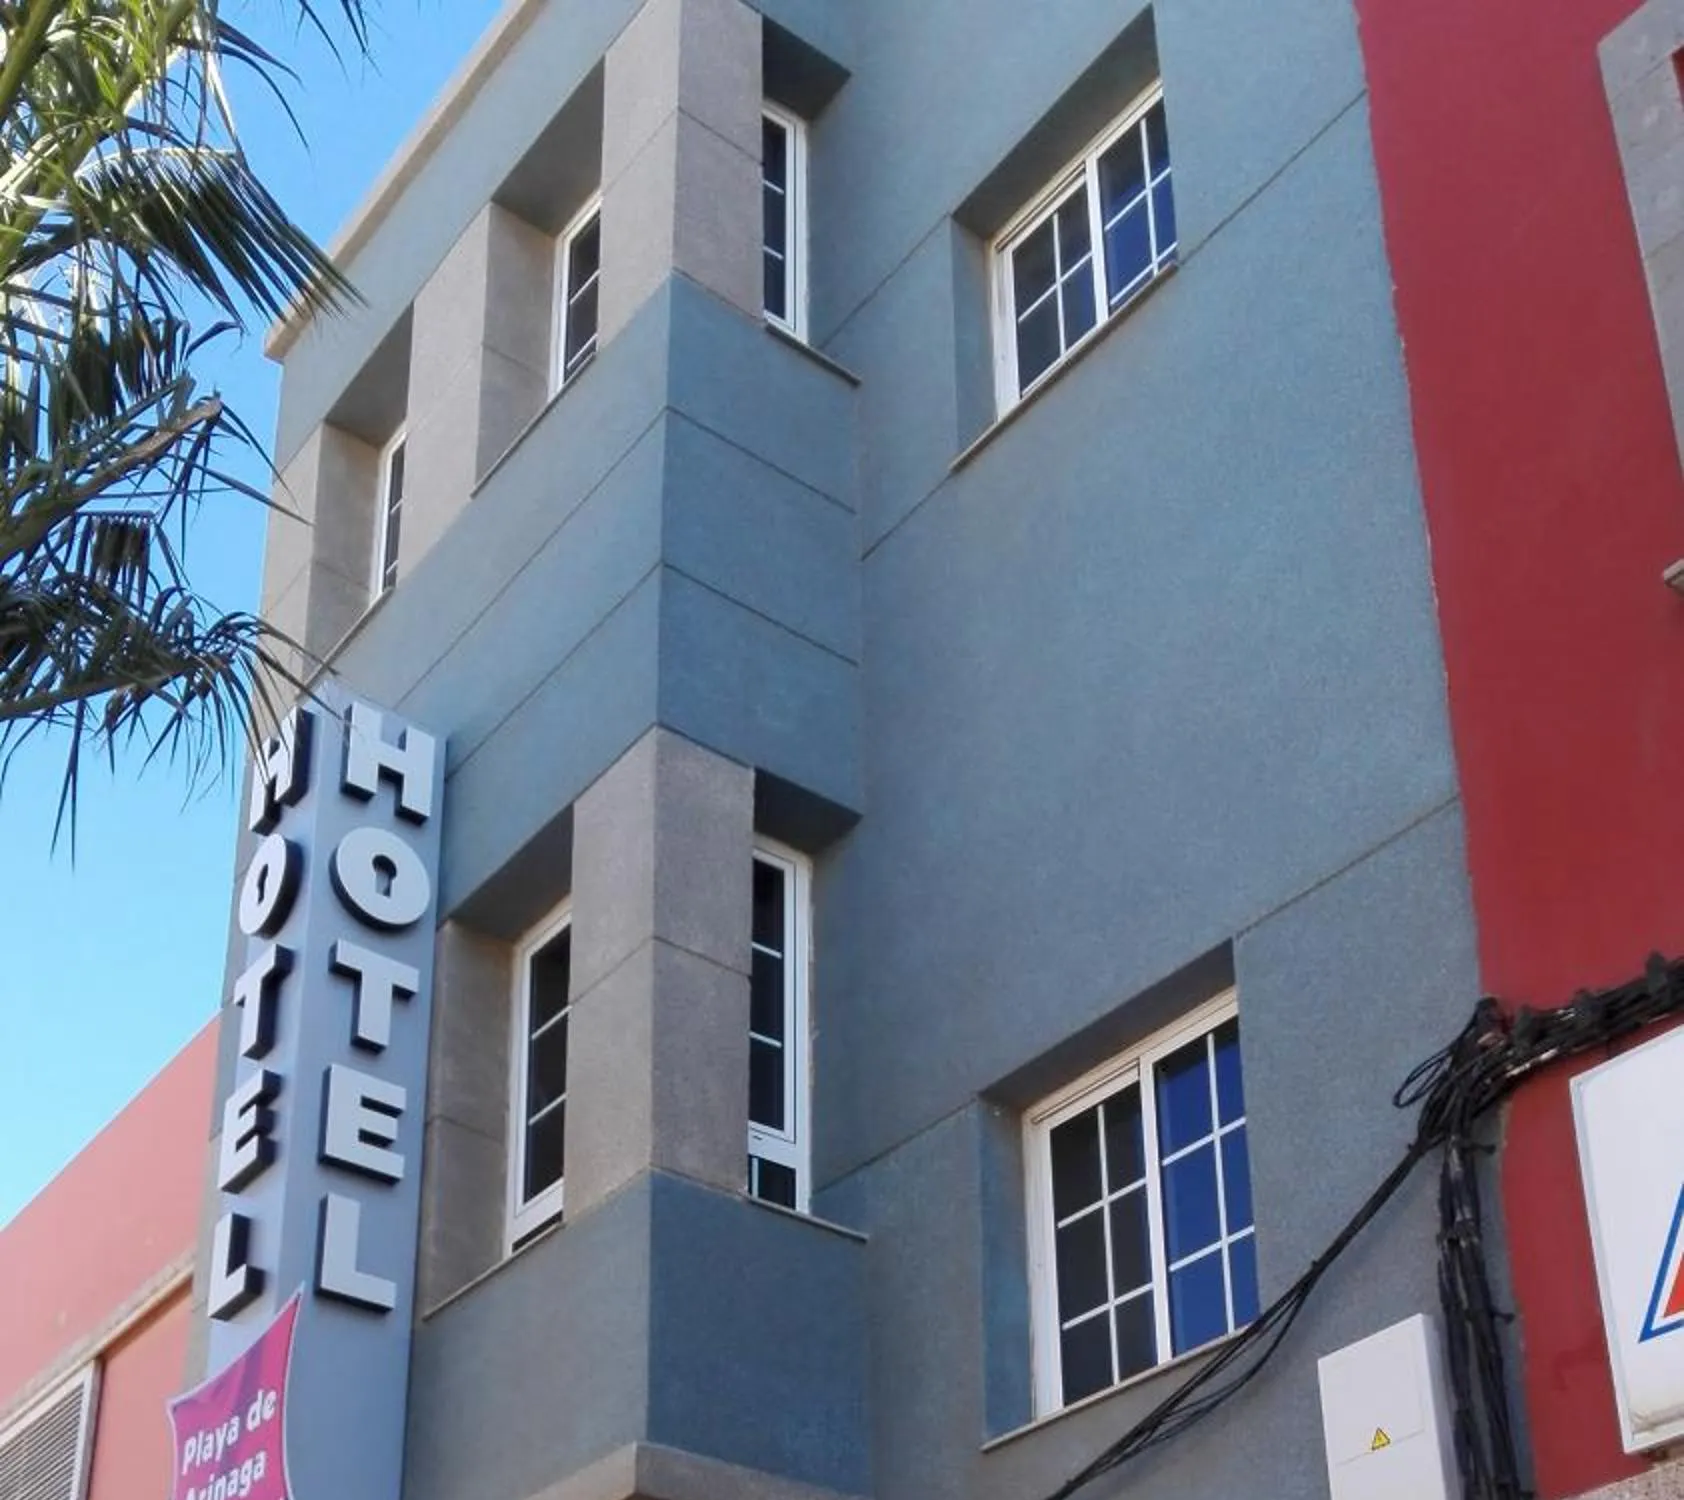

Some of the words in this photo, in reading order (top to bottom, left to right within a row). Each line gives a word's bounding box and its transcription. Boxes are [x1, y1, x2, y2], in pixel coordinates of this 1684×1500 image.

[209, 706, 312, 1321] HOTEL
[315, 700, 437, 1312] HOTEL
[182, 1413, 240, 1475] Playa
[246, 1388, 277, 1432] de
